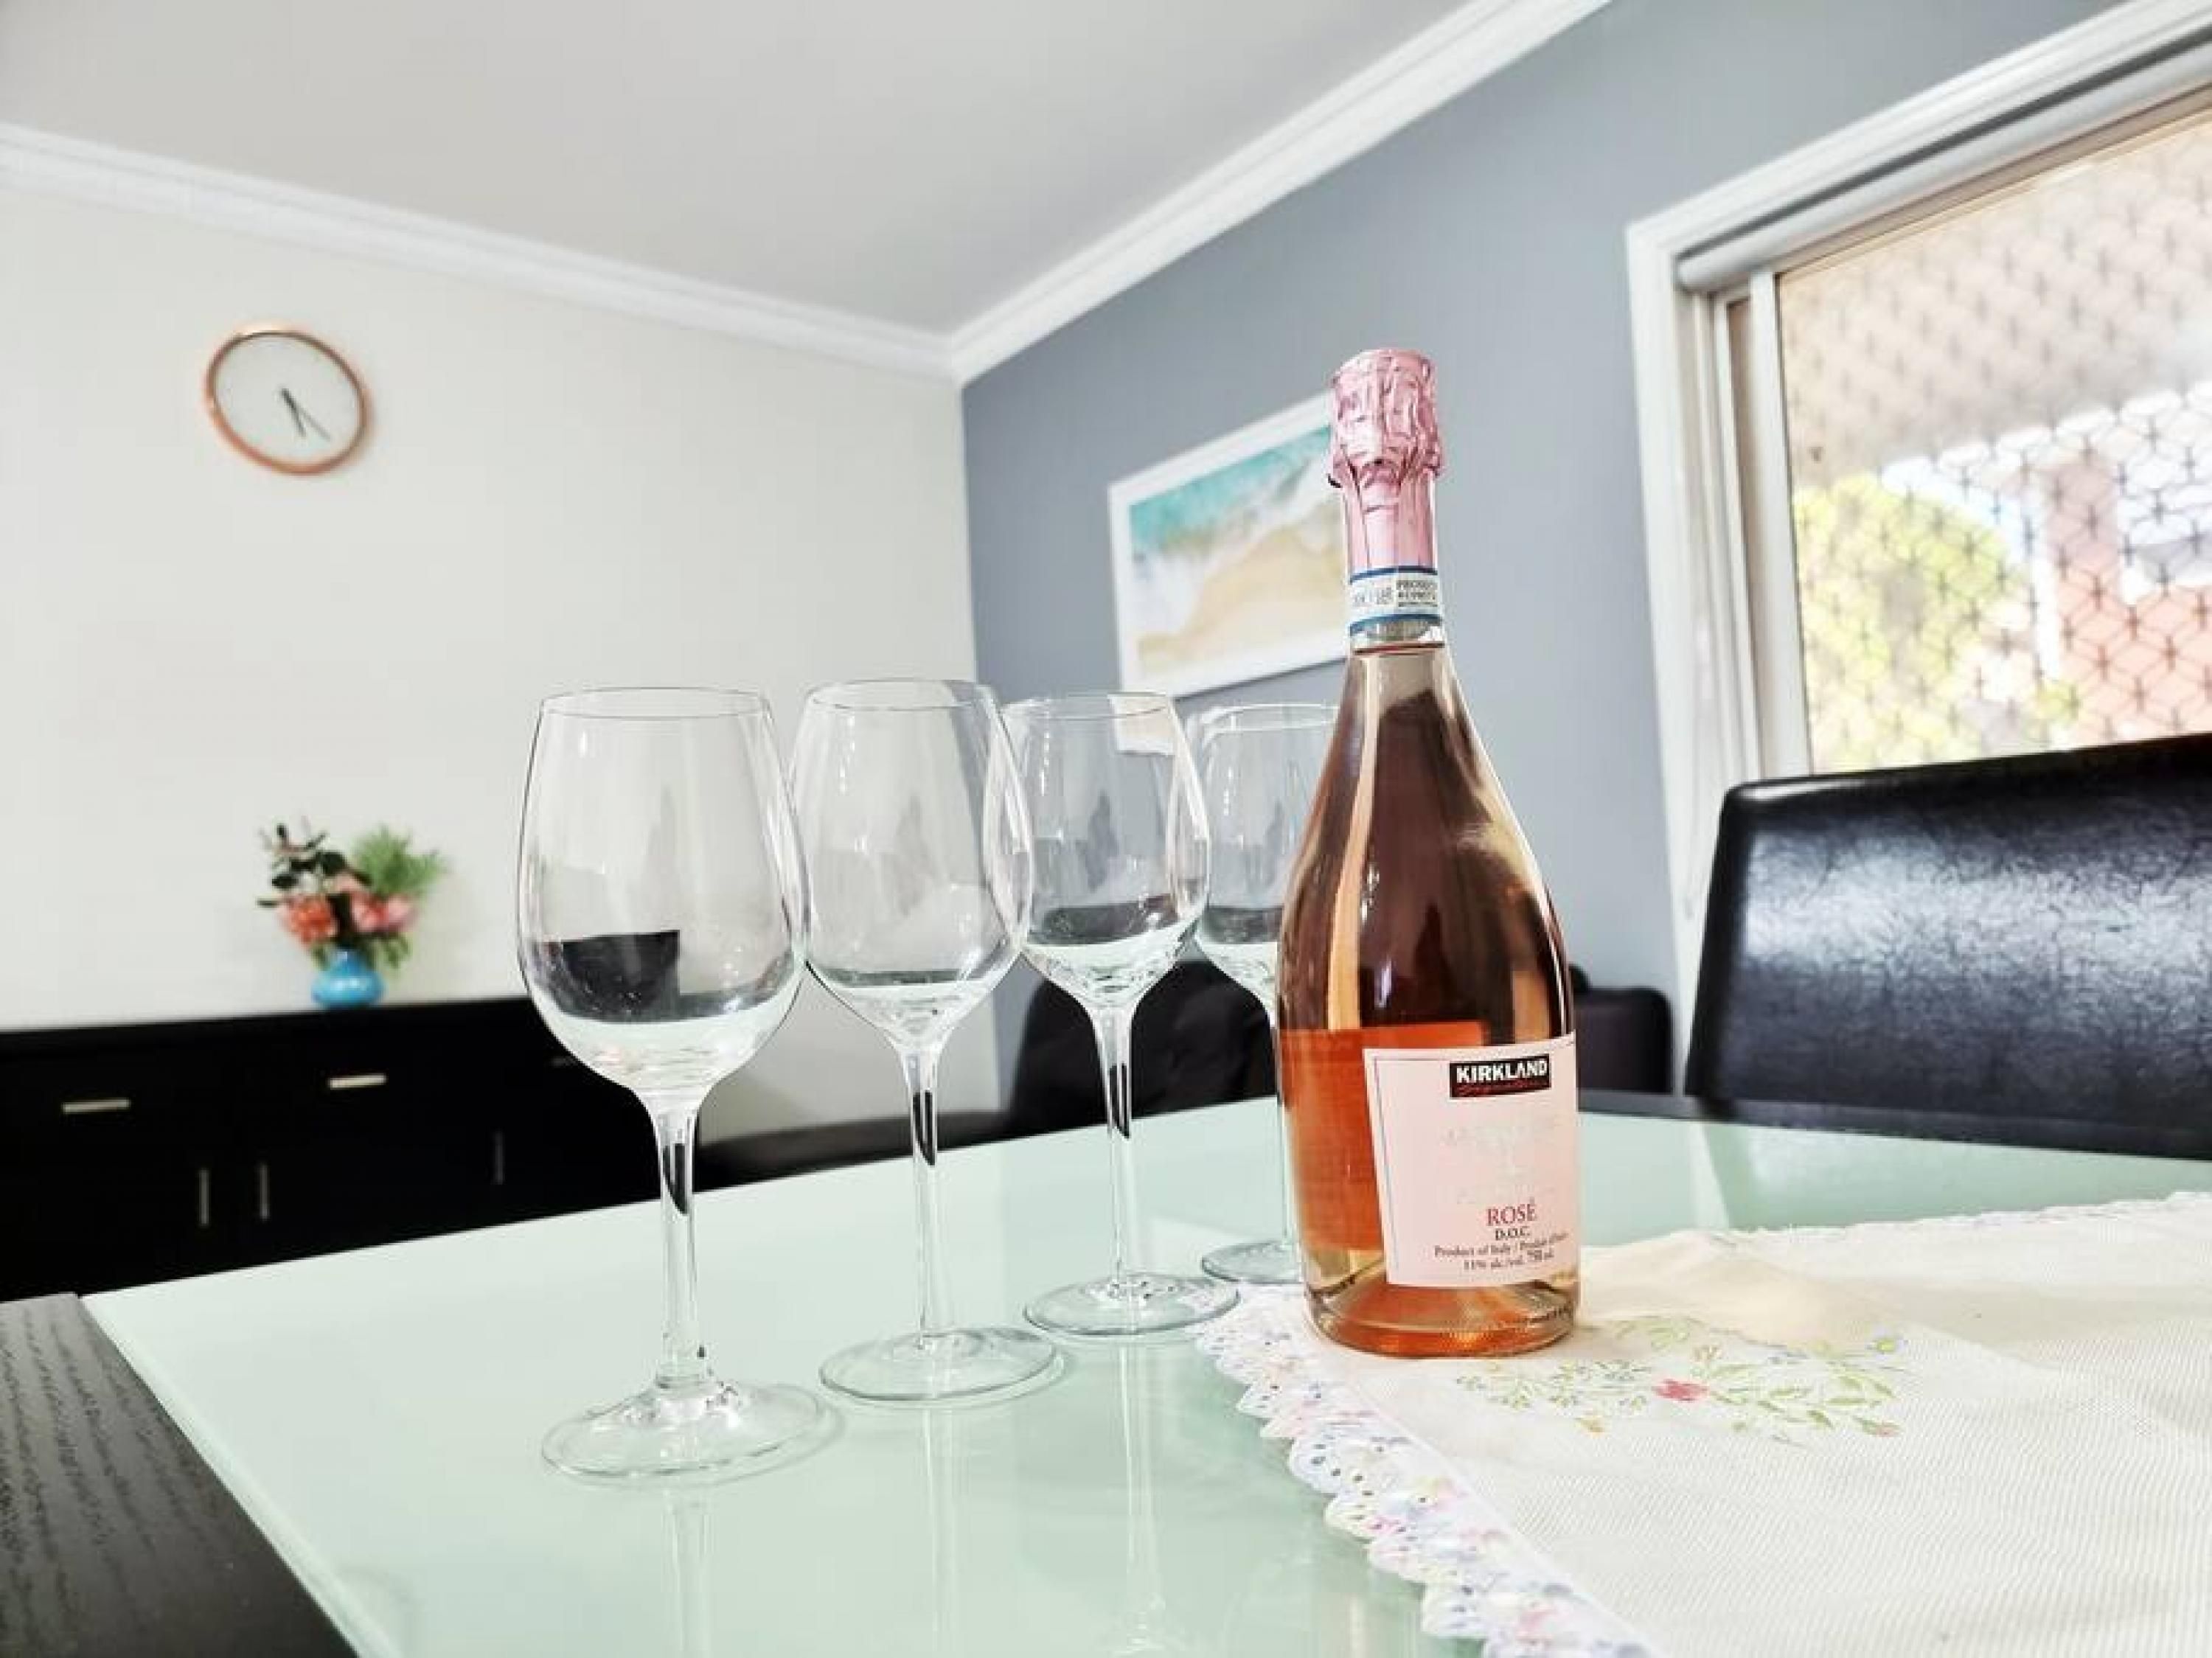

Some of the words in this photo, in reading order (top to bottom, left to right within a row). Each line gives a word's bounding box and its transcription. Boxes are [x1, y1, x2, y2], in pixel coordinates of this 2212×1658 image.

[1456, 1059, 1548, 1083] KIRKLAND
[1486, 1197, 1538, 1226] ROSÉ
[1434, 1244, 1475, 1258] Product
[1477, 1244, 1489, 1254] of
[1490, 1242, 1511, 1255] Italy
